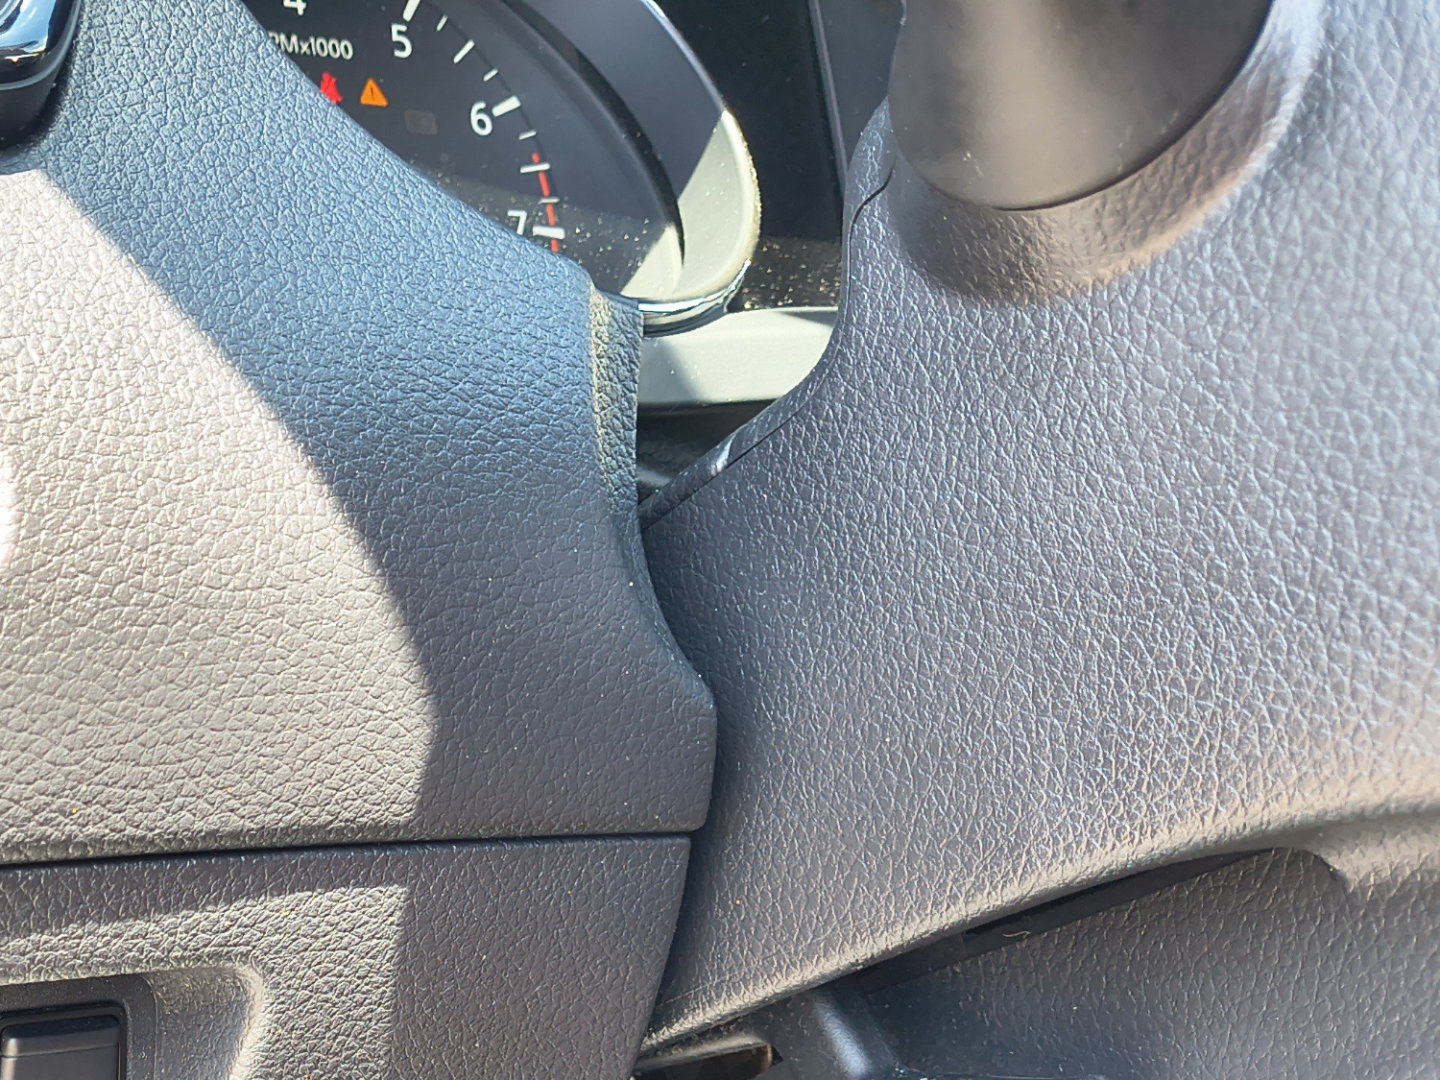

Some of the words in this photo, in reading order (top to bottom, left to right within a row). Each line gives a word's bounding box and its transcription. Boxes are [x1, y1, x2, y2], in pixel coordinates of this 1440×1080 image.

[391, 23, 412, 58] 5
[470, 101, 493, 136] 6
[507, 209, 527, 235] 7
